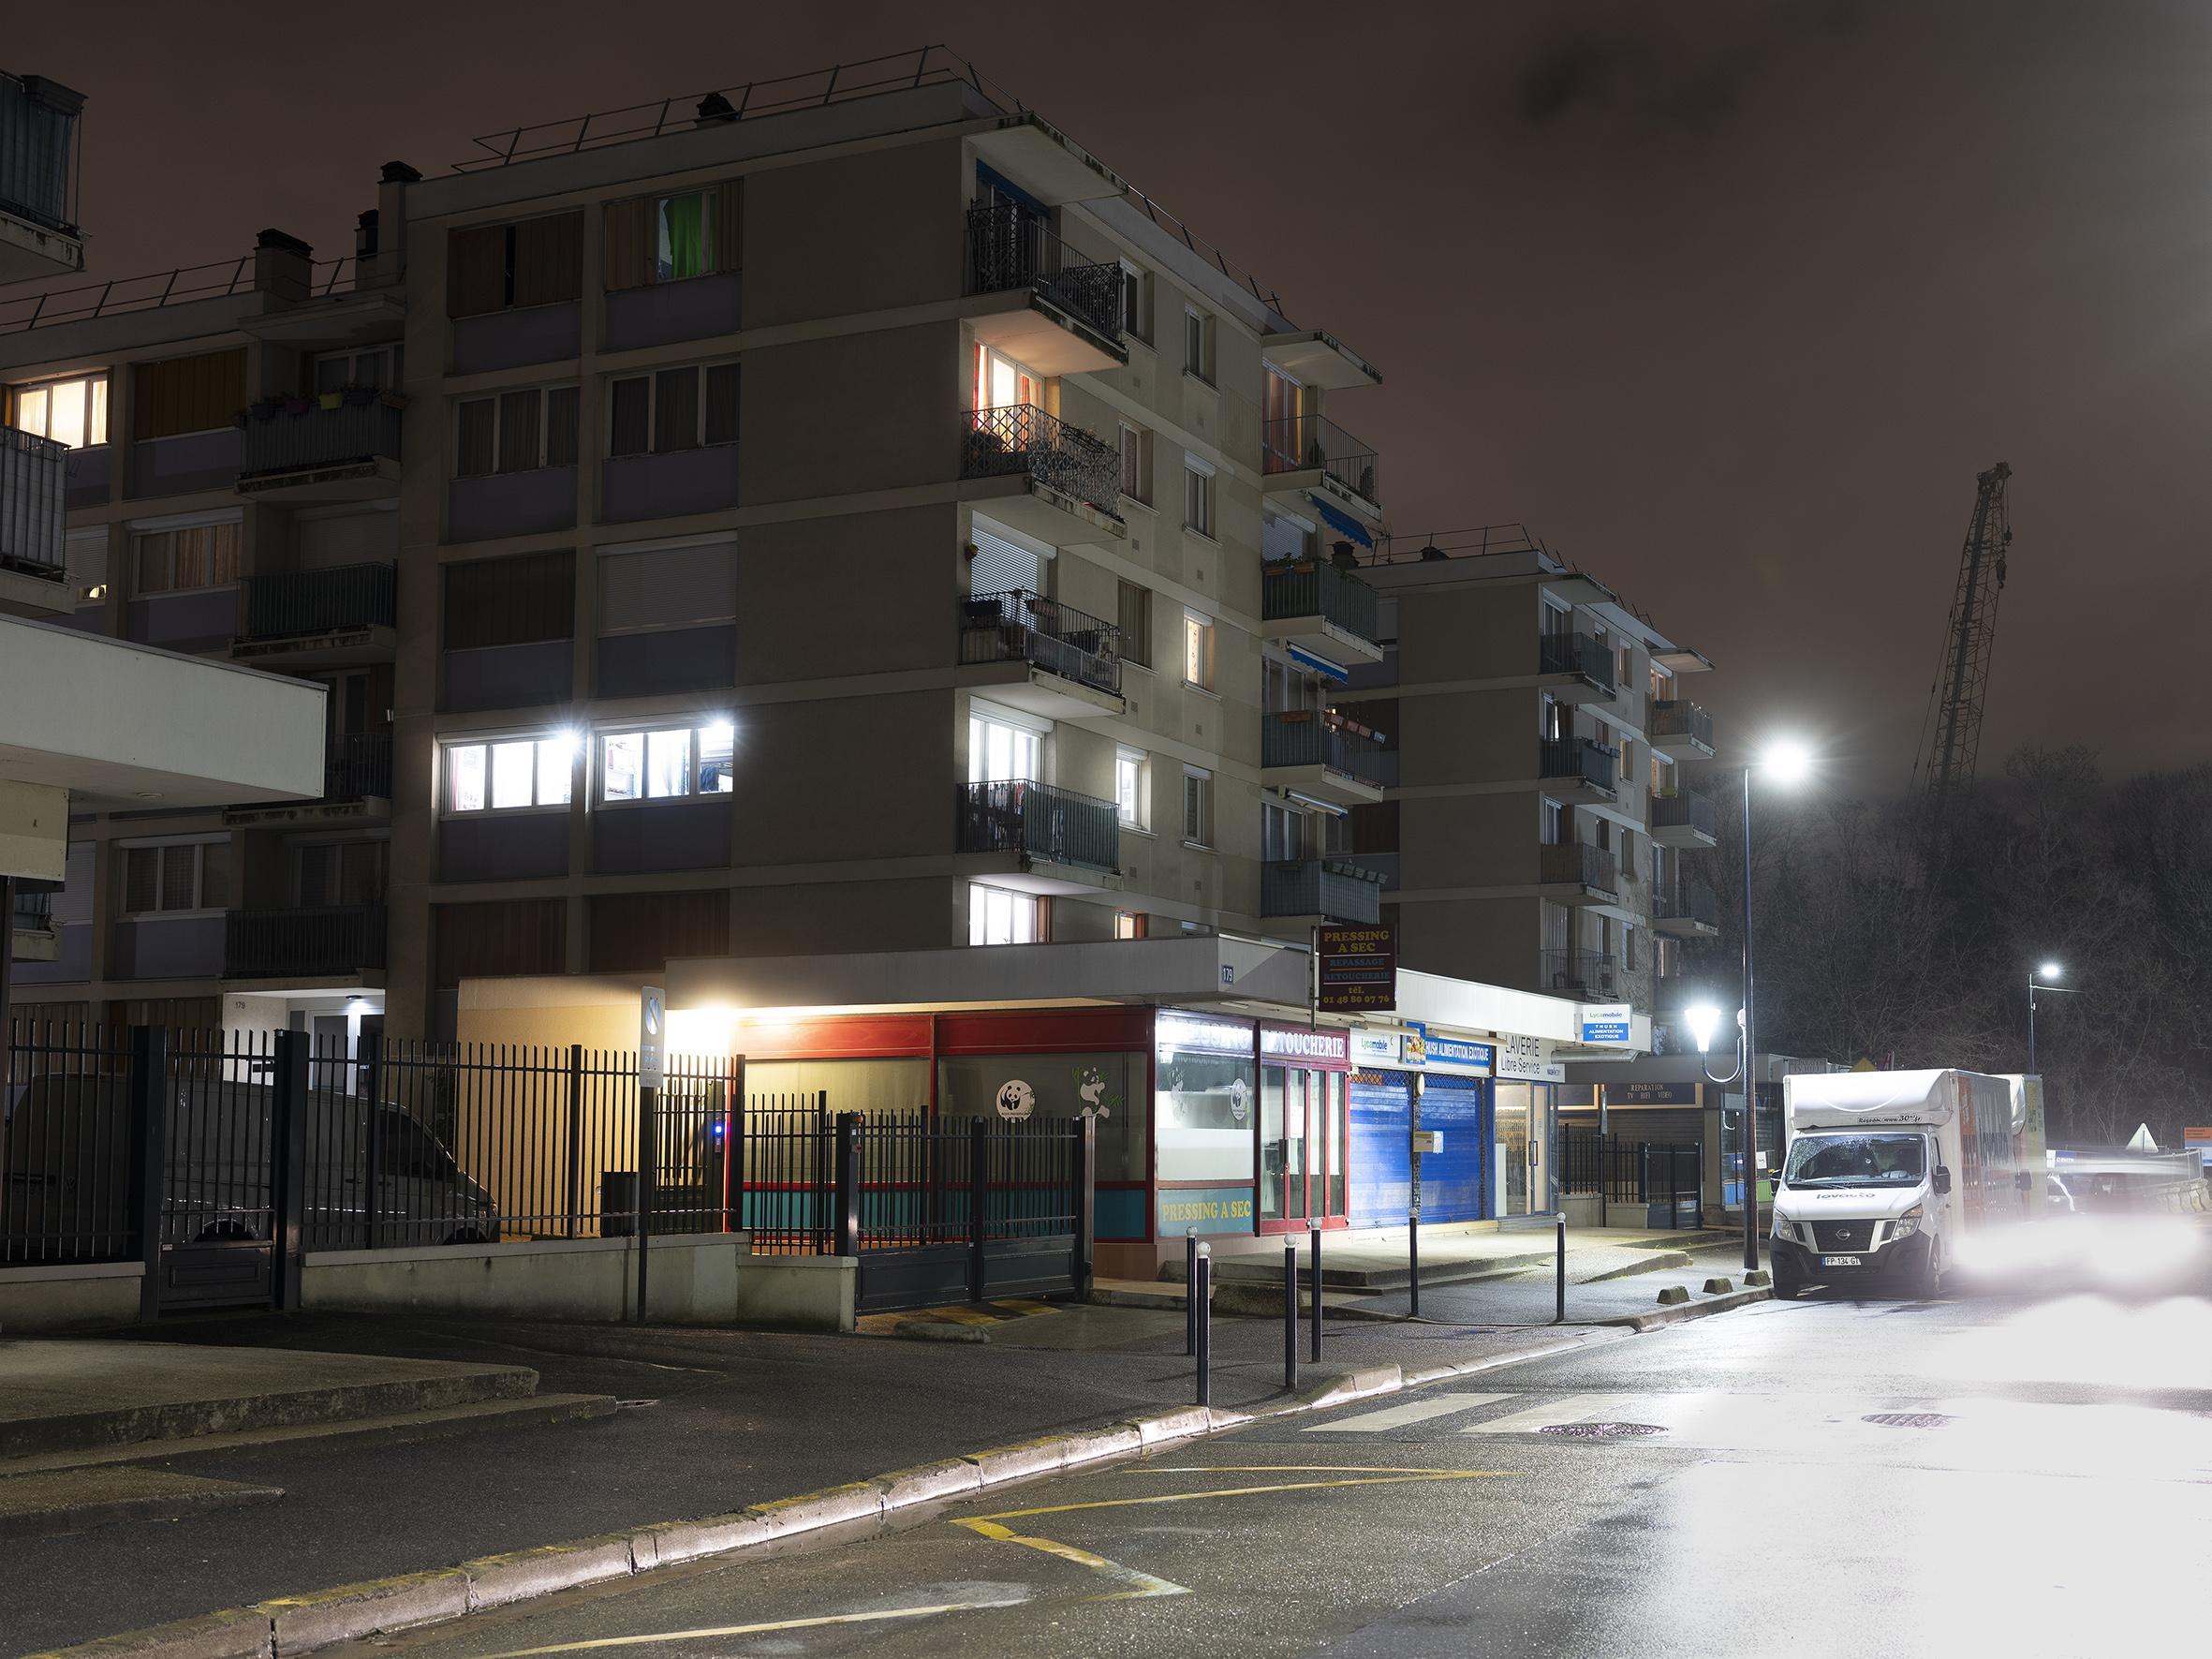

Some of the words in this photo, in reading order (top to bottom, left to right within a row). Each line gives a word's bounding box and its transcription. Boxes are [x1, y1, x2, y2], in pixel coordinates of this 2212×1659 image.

[1323, 930, 1391, 942] PRESSING
[1338, 943, 1349, 954] A
[1350, 942, 1376, 953] SEC
[1329, 958, 1385, 967] REPASSAGE
[1223, 968, 1232, 982] 179
[1323, 971, 1390, 981] RETOUCHERIE
[1336, 997, 1349, 1005] 48
[1364, 996, 1377, 1004] 07
[1378, 995, 1390, 1003] 76
[1261, 1029, 1344, 1059] TOUCHERIE
[1361, 1037, 1388, 1050] Lycamobile
[1505, 1034, 1540, 1058] LAVERIE
[1438, 1043, 1468, 1059] ALIMENTATION
[1468, 1045, 1489, 1061] EXOTIQUE
[1500, 1056, 1517, 1072] Libre
[1518, 1058, 1541, 1074] Service
[1162, 1202, 1218, 1222] PRESSING
[1220, 1201, 1229, 1219] A
[1231, 1200, 1251, 1218] SEC
